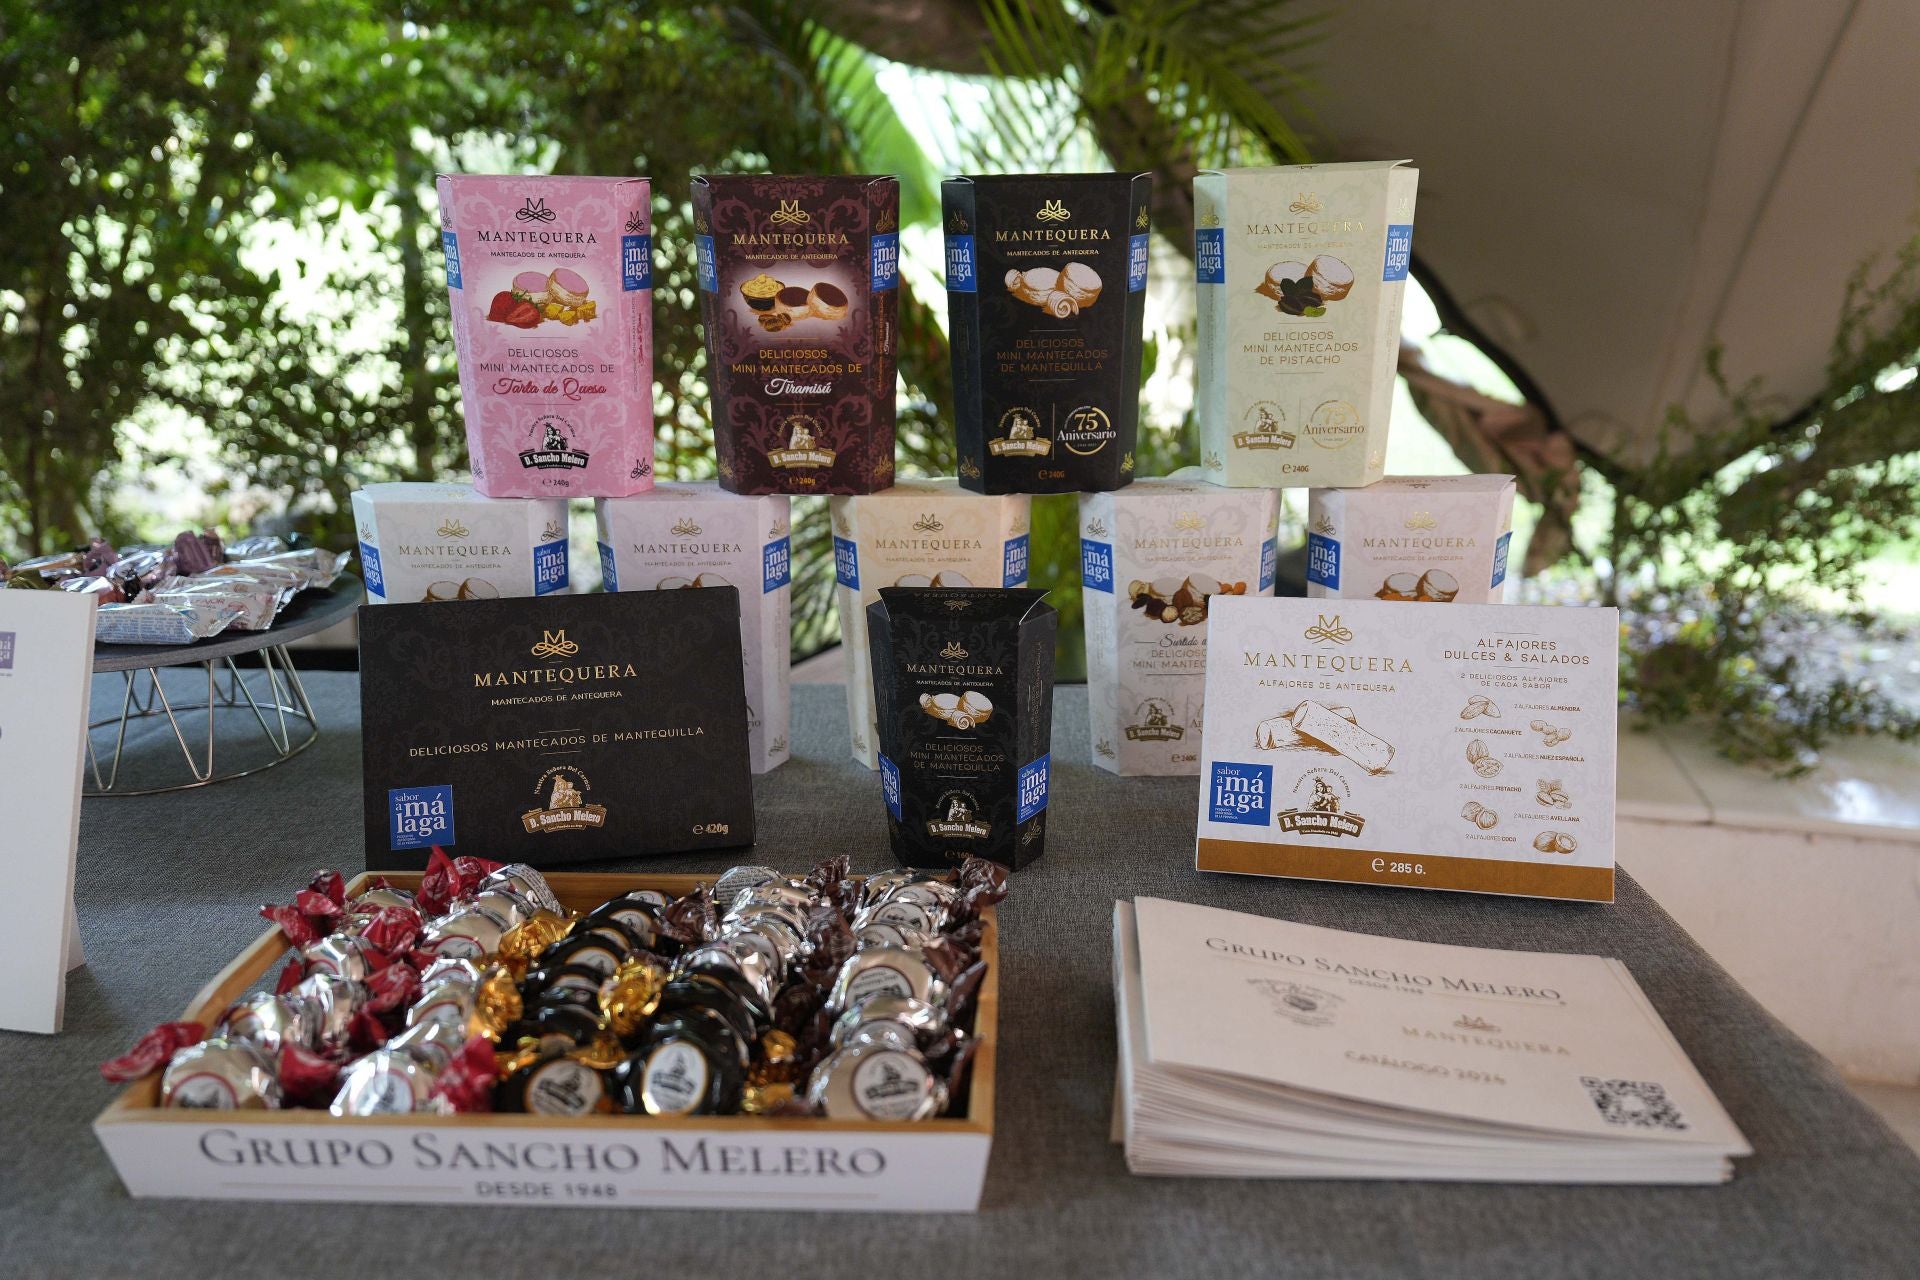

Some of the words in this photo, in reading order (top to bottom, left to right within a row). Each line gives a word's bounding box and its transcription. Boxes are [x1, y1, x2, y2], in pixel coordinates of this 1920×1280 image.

[1246, 220, 1366, 236] MANTEQUERA
[478, 230, 598, 245] MANTEQUERA
[733, 233, 849, 246] MANTEQUERA
[995, 229, 1111, 243] MANTEQUERA
[1392, 232, 1409, 252] má
[548, 252, 586, 260] ANTEQUERA
[878, 242, 896, 262] má
[1198, 253, 1222, 274] laga
[1387, 250, 1408, 272] laga
[625, 260, 649, 280] laga
[874, 260, 896, 280] laga
[948, 262, 972, 281] laga
[1130, 260, 1147, 280] laga
[1263, 331, 1334, 341] DELICIOSOS
[1016, 338, 1085, 349] DELICIOSOS
[1243, 344, 1268, 354] MINI
[1274, 342, 1359, 352] MANTECADOS
[508, 348, 579, 358] DELICIOSOS
[760, 349, 828, 359] DELICIOSOS
[996, 351, 1021, 361] MINI
[1027, 350, 1108, 361] MANTECADOS
[1260, 356, 1274, 365] DE
[1280, 354, 1341, 365] PISTACHO
[480, 363, 505, 372] MINI
[510, 364, 594, 374] MANTECADOS
[600, 364, 614, 373] DE
[732, 363, 756, 374] MINI
[761, 364, 843, 374] MANTECADOS
[848, 363, 862, 373] DE
[1001, 363, 1016, 373] DE
[1020, 362, 1103, 372] MANTEQUILLA
[492, 378, 540, 396] Tarta
[543, 381, 559, 394] de
[562, 378, 607, 400] Queso
[764, 378, 832, 396] Tiramisú
[1074, 412, 1098, 431] 75
[1057, 428, 1116, 441] Aniversario
[1302, 423, 1364, 435] Aniversario
[1002, 441, 1026, 450] Sancho
[1246, 435, 1270, 444] Sancho
[524, 456, 533, 466] D.
[532, 452, 560, 464] Sancho
[562, 452, 585, 466] Melero
[781, 452, 808, 462] Sancho
[634, 544, 742, 555] MANTEQUERA
[876, 539, 982, 551] MANTEQUERA
[1134, 537, 1244, 549] MANTEQUERA
[1362, 537, 1476, 549] MANTEQUERA
[398, 545, 512, 557] MANTEQUERA
[540, 544, 564, 566] má
[1314, 546, 1336, 564] má
[1088, 550, 1109, 568] má
[538, 562, 565, 583] laga
[766, 562, 788, 580] laga
[1006, 559, 1026, 576] laga
[1084, 562, 1110, 582] laga
[1310, 558, 1336, 578] laga
[1159, 634, 1198, 648] Surtido
[1476, 638, 1557, 650] ALFAJORES
[1133, 660, 1156, 668] MINI
[1244, 652, 1413, 673] MANTEQUERA
[1444, 650, 1496, 661] DULCES
[1504, 652, 1513, 662] &
[1521, 654, 1590, 665] SALADOS
[474, 663, 638, 688] MANTEQUERA
[906, 663, 1004, 676] MANTEQUERA
[1258, 679, 1314, 689] ALFAJORES
[1336, 682, 1396, 693] ANTEQUERA
[1522, 676, 1568, 684] ALFAJORES
[1522, 682, 1551, 690] SABOR
[491, 695, 553, 706] MANTECADOS
[556, 694, 568, 702] DE
[571, 690, 622, 700] ANTEQUERA
[410, 742, 489, 758] DELICIOSOS
[495, 735, 586, 751] MANTECADOS
[592, 733, 608, 744] DE
[614, 726, 704, 742] MANTEQUILLA
[925, 743, 984, 752] DELICIOSOS
[910, 751, 930, 760] MINI
[934, 753, 1005, 762] MANTECADOS
[914, 760, 926, 769] DE
[930, 762, 1000, 772] MANTEQUILLA
[1216, 766, 1240, 775] sabor
[1025, 762, 1046, 790] má
[1216, 776, 1224, 784] a
[1224, 772, 1266, 794] má
[395, 793, 420, 802] sabor
[1022, 782, 1046, 806] laga
[1216, 786, 1264, 814] laga
[404, 792, 446, 817] má
[396, 812, 448, 836] laga
[529, 818, 540, 828] D.
[540, 810, 572, 824] Sancho
[574, 810, 600, 823] Melero
[1284, 817, 1294, 828] D.
[1294, 815, 1328, 826] Sancho
[1330, 816, 1359, 834] Melero
[706, 823, 728, 834] 420g
[939, 823, 964, 832] Sancho
[964, 824, 986, 835] Melero
[1390, 862, 1412, 873] 285
[1414, 864, 1426, 874] G.
[1205, 937, 1305, 965] GRUPO
[1315, 957, 1432, 985] SANCHO
[1439, 975, 1561, 998] MELERO
[1402, 1025, 1571, 1056] MANTEQUERA
[199, 1128, 394, 1170] GRUPO
[412, 1132, 640, 1174] SANCHO
[660, 1136, 888, 1178] MELERO
[475, 1181, 554, 1199] DESDE
